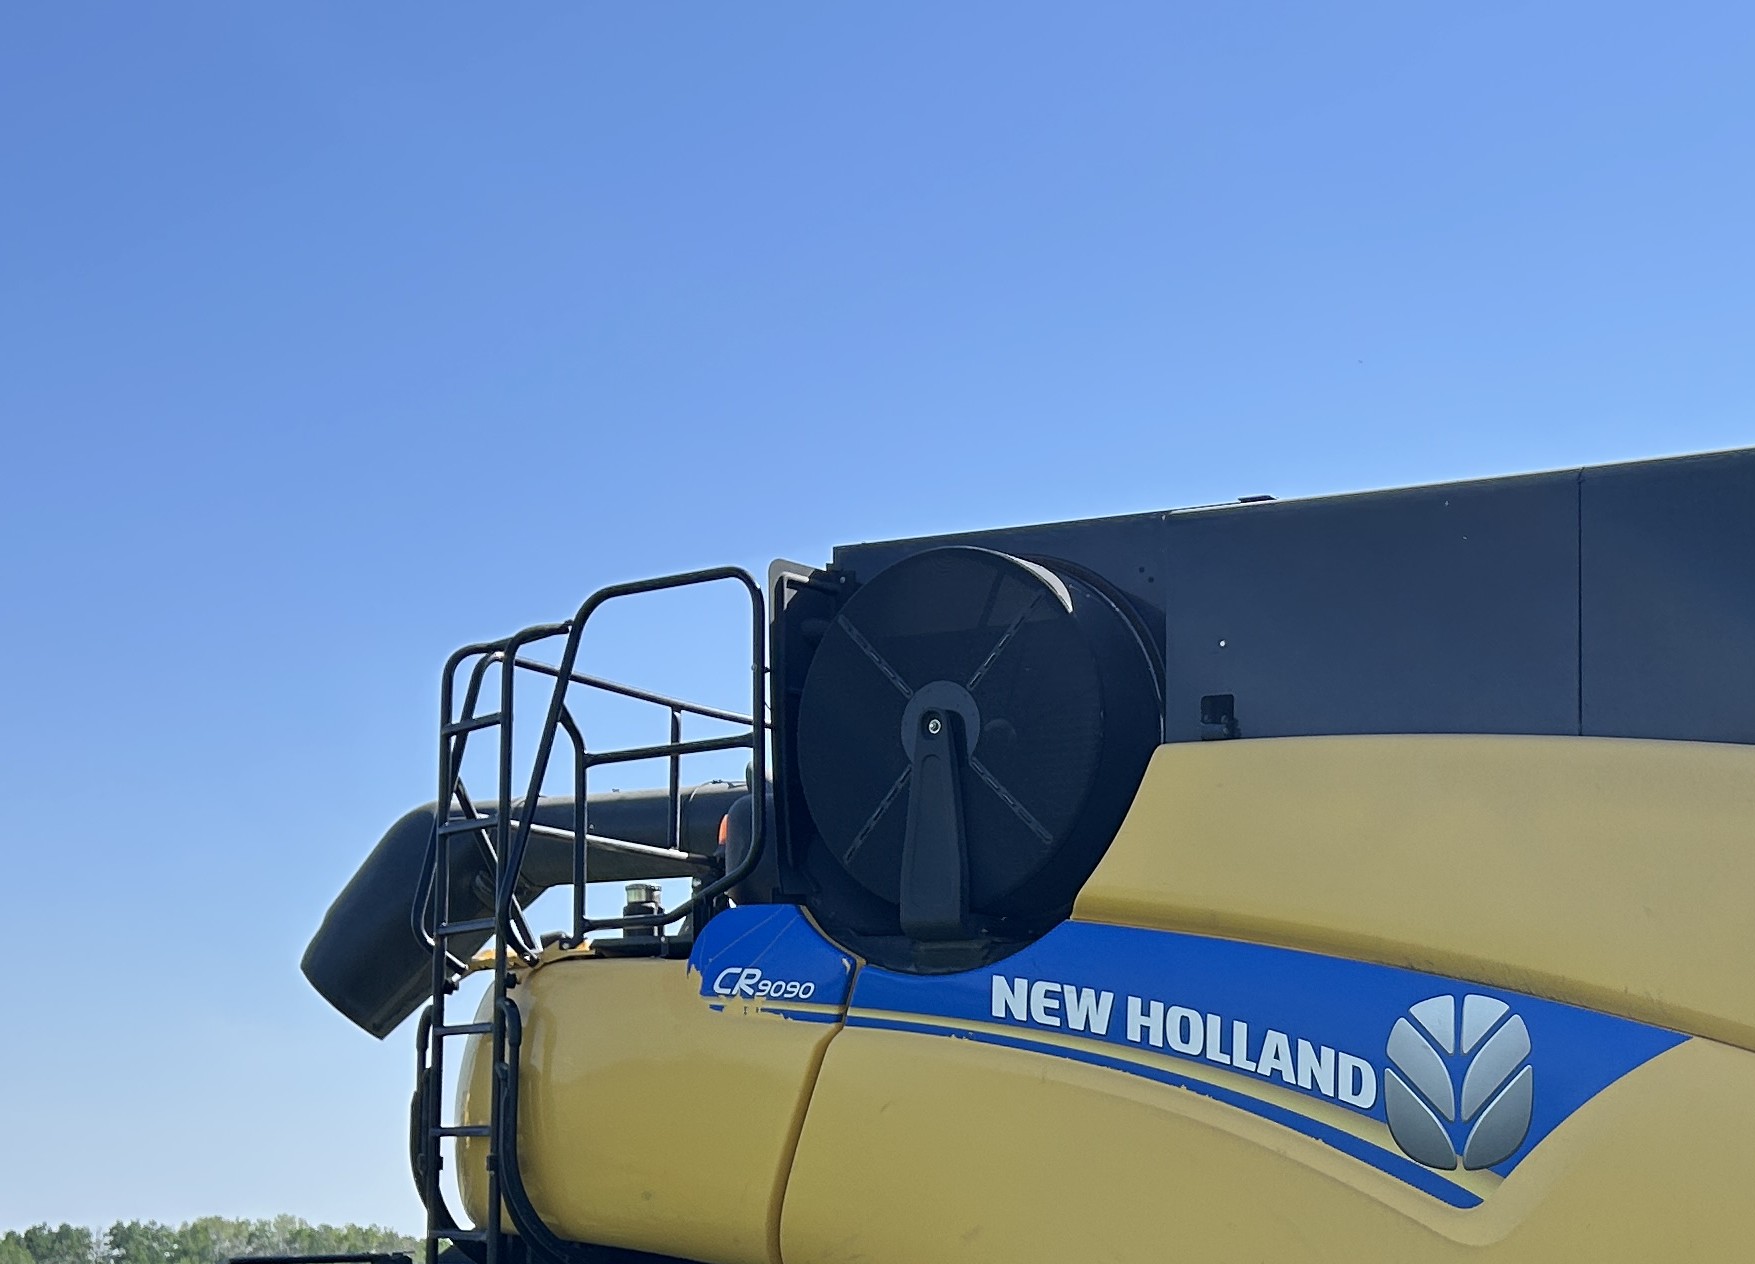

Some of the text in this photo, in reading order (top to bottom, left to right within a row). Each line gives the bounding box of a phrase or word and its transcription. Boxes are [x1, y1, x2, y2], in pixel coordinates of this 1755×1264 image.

[713, 967, 815, 999] CR9090
[991, 974, 1377, 1109] NEW HOLLAND
